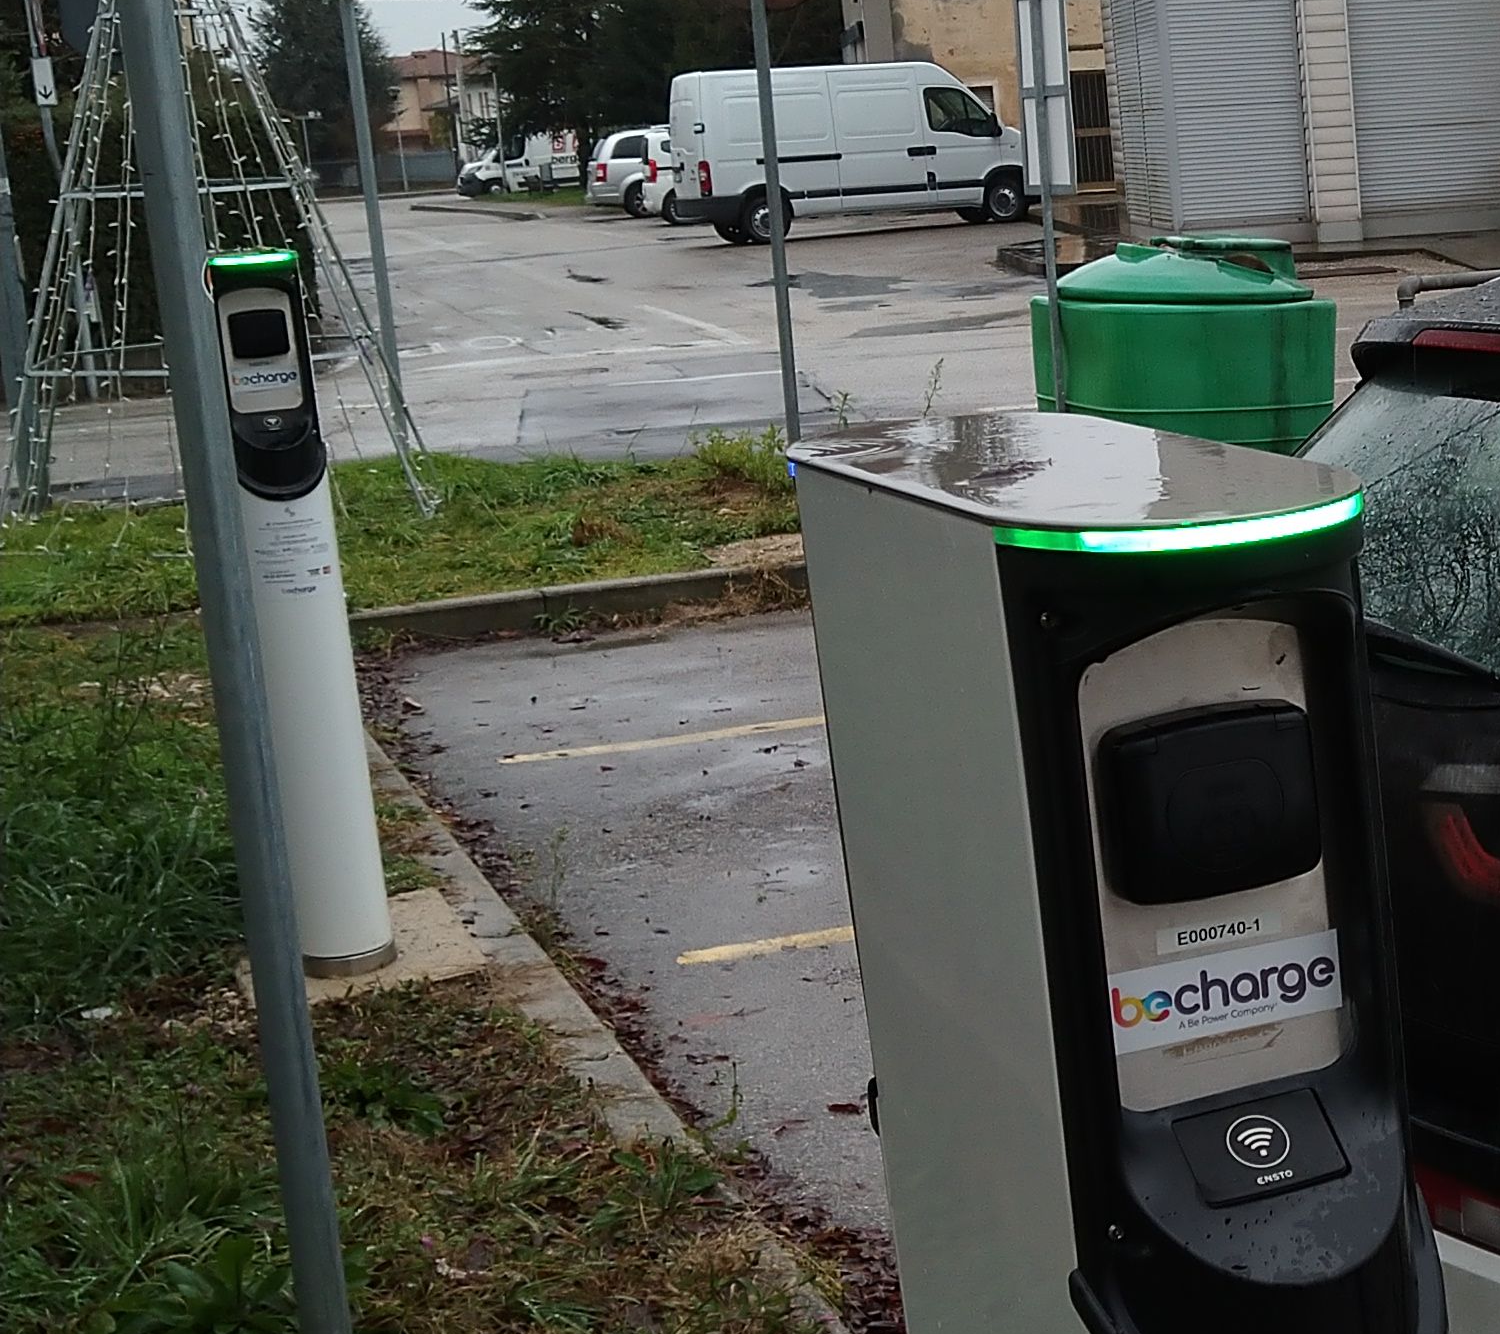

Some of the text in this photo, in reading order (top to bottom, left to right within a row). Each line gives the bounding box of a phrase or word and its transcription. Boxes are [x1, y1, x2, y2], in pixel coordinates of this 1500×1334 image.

[1177, 918, 1261, 947] E000740-1
[1111, 955, 1336, 1029] becharge
[1178, 1002, 1275, 1031] A Be Power Company
